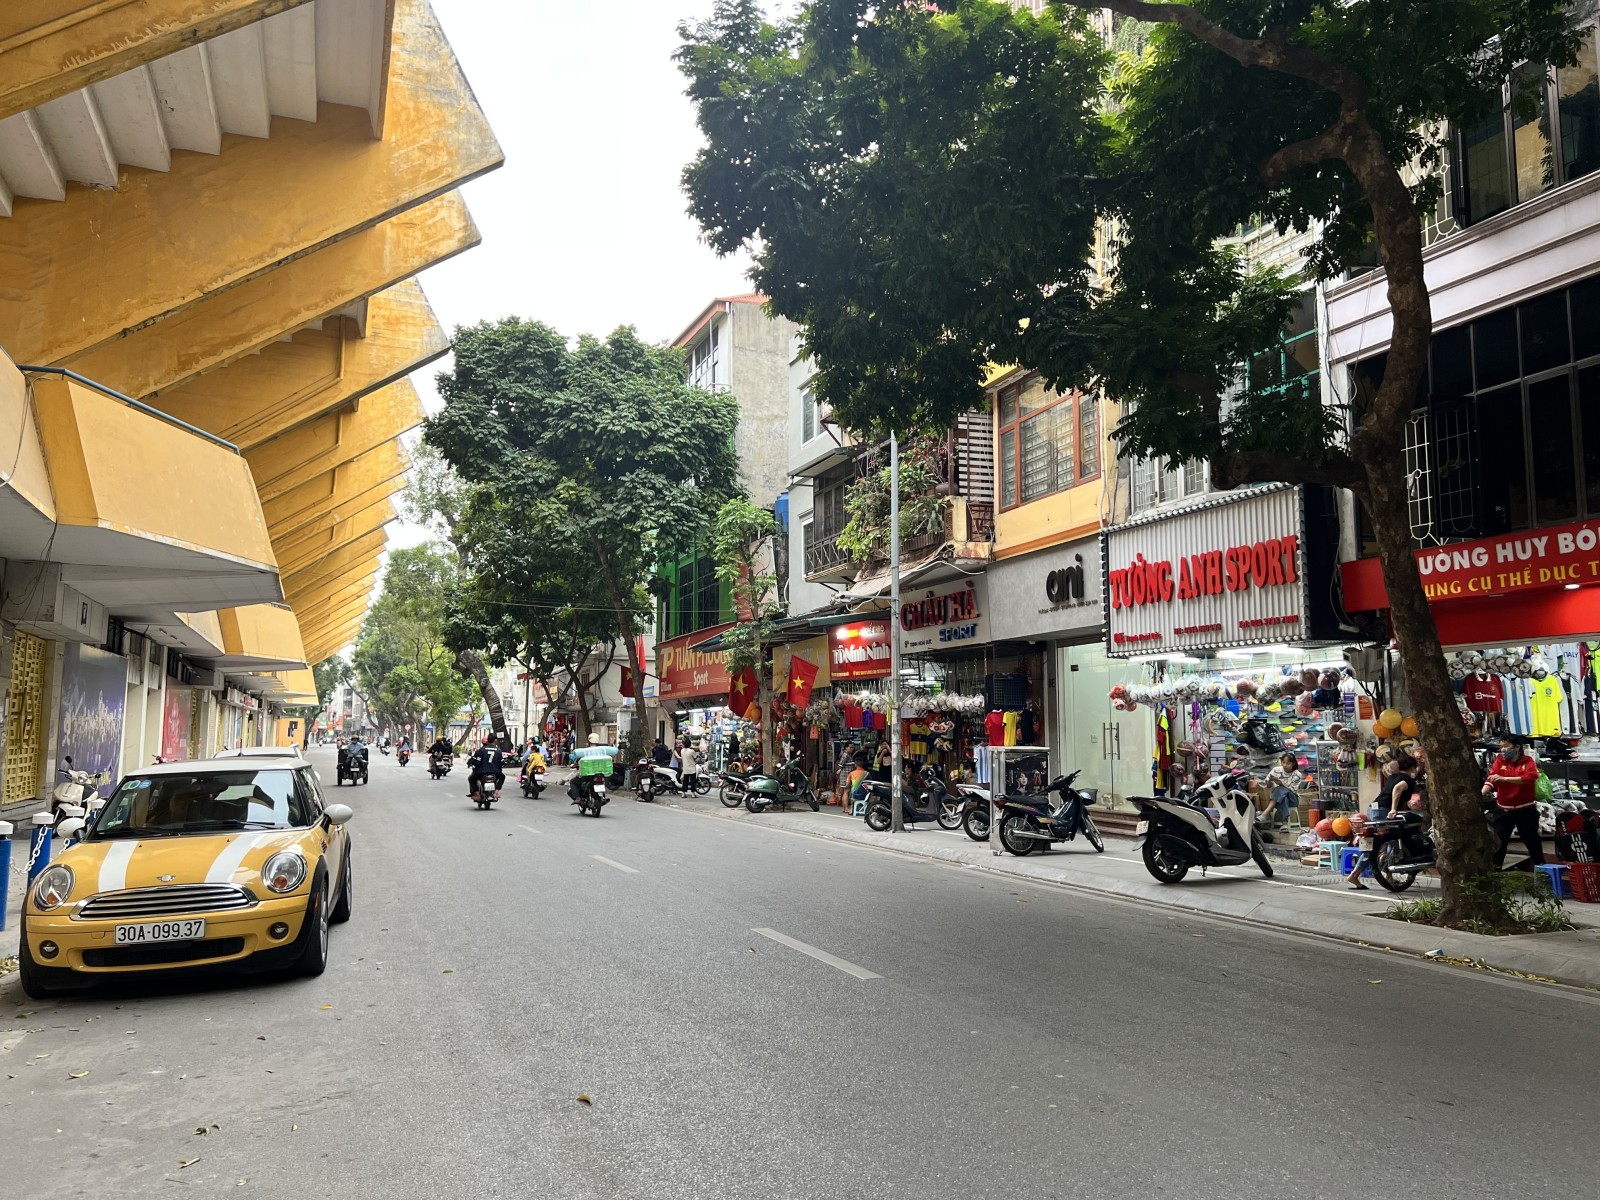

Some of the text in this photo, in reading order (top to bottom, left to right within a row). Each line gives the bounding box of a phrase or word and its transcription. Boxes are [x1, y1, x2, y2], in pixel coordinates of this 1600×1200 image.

[1495, 535, 1549, 564] HUY
[1557, 523, 1600, 555] BÓ
[1046, 552, 1084, 604] ani
[1109, 534, 1300, 610] TƯỞNG ANH SPORT
[1468, 575, 1492, 593] CỤ
[1497, 563, 1532, 589] THỂ
[1539, 562, 1581, 584] DỤC
[938, 623, 977, 642] SPORT
[693, 670, 708, 690] Sport
[487, 750, 495, 763] 7
[117, 920, 203, 942] 30A-099.37
